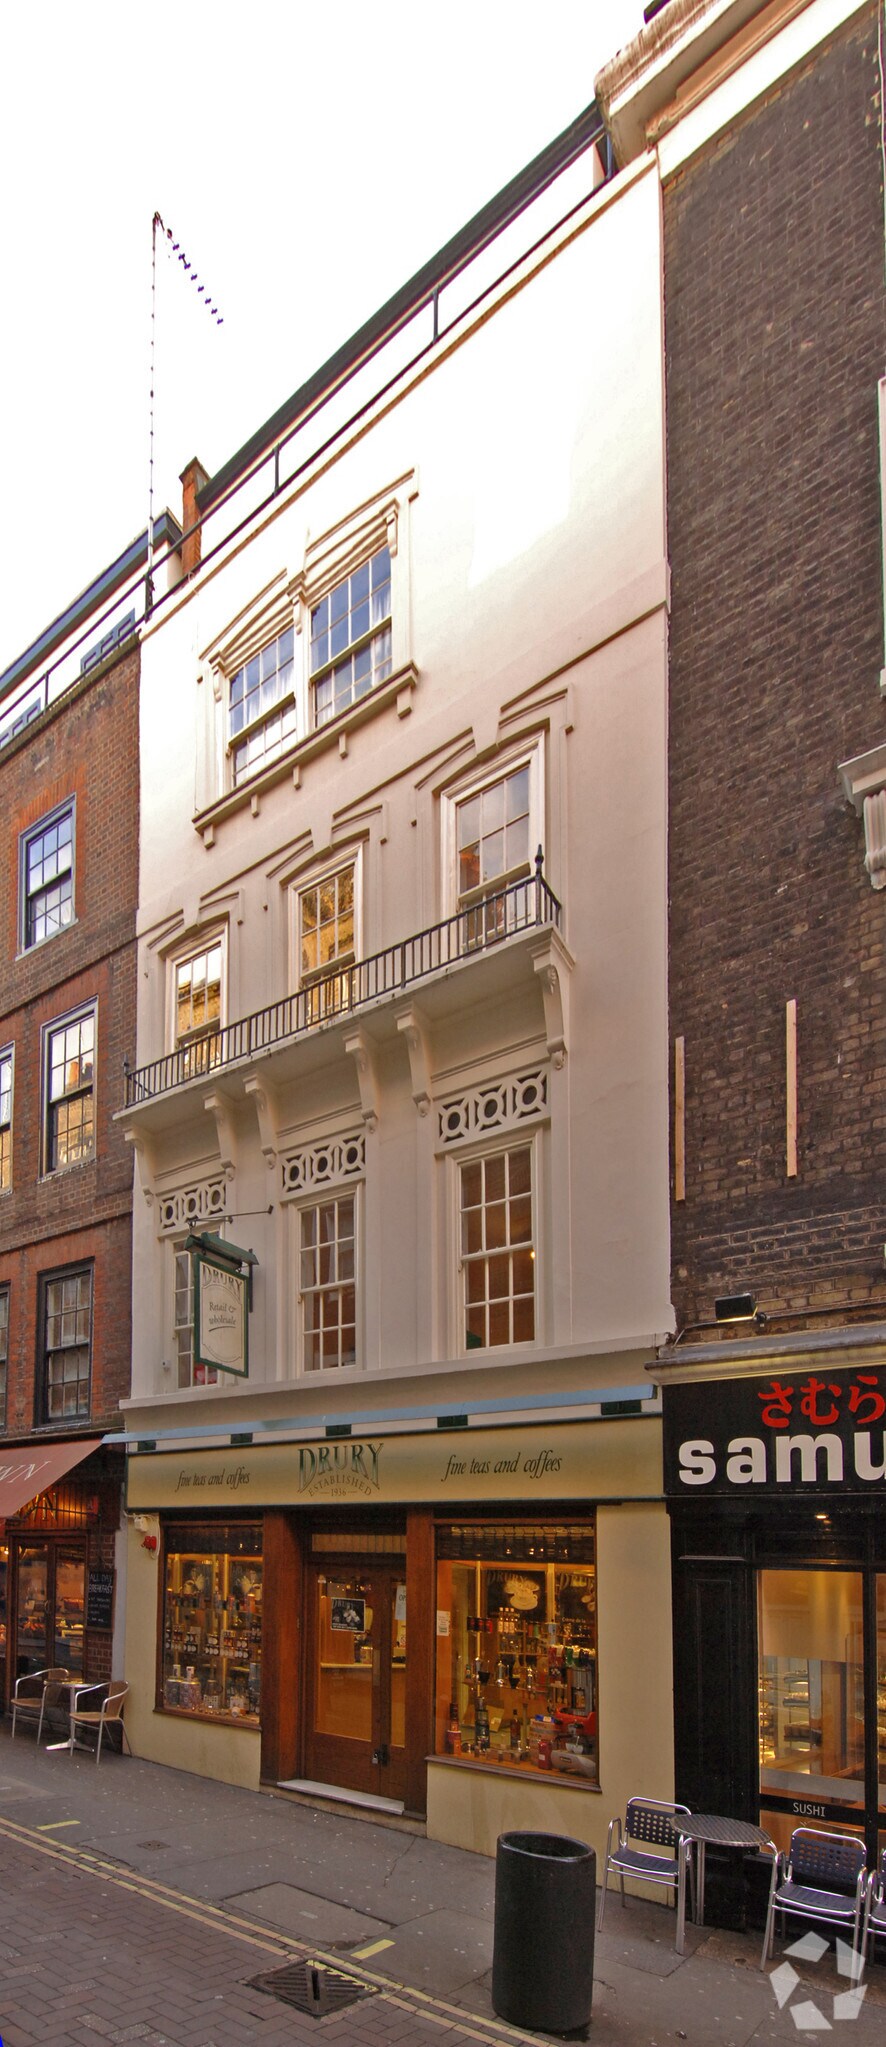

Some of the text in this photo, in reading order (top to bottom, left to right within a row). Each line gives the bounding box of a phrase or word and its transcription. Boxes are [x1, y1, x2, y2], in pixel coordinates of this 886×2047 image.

[202, 1264, 242, 1302] DRURY
[209, 1301, 227, 1312] Retail
[208, 1314, 237, 1325] wholesale
[757, 1375, 886, 1428] さむら
[297, 1442, 384, 1494] DRURY
[441, 1449, 563, 1481] fine teas and coffees
[192, 1473, 207, 1486] teas
[208, 1468, 226, 1486] and
[226, 1466, 250, 1490] coffees
[308, 1474, 372, 1497] ESTABLISHED
[331, 1487, 347, 1497] 1936
[793, 1802, 826, 1817] SUSHI
